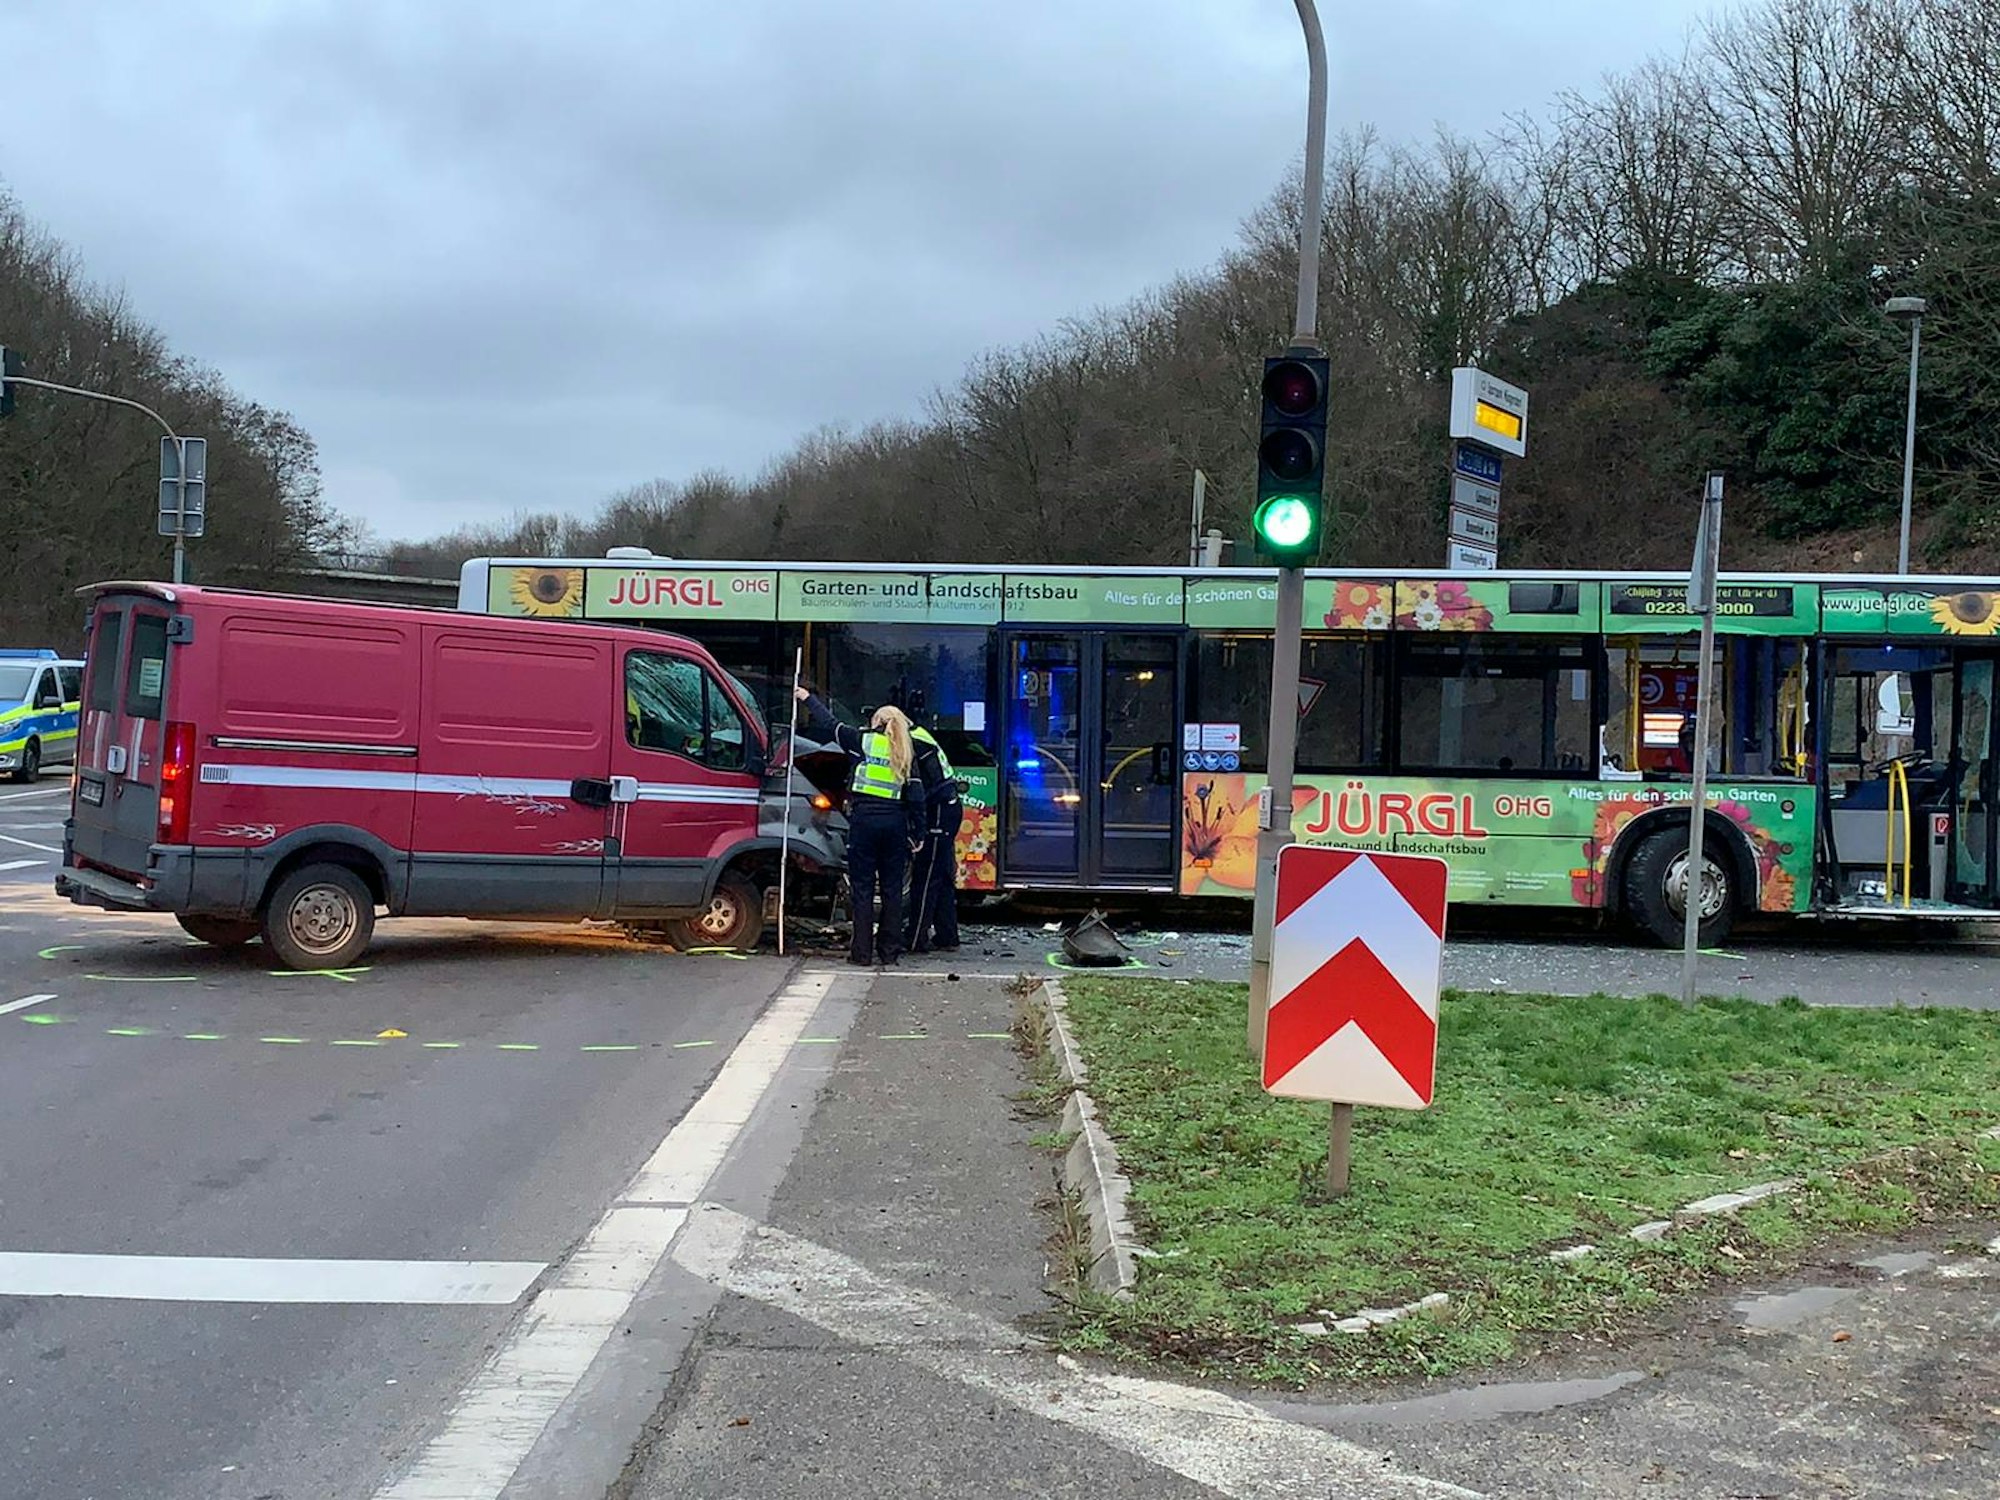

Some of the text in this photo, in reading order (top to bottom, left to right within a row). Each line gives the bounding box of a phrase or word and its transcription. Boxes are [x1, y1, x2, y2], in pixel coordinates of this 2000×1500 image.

[608, 571, 769, 606] JÜRGL OHG
[802, 579, 1078, 599] Garten- und Landschaftsbau
[1104, 590, 1138, 605] Alles
[1142, 590, 1161, 606] für
[1194, 588, 1253, 604] schönen
[1005, 600, 1024, 611] 912
[1568, 788, 1777, 803] Alles für den schen Garten
[1305, 781, 1488, 838] JÜRGL
[1495, 796, 1552, 817] OHG
[1386, 841, 1487, 855] Landschaftsbau
